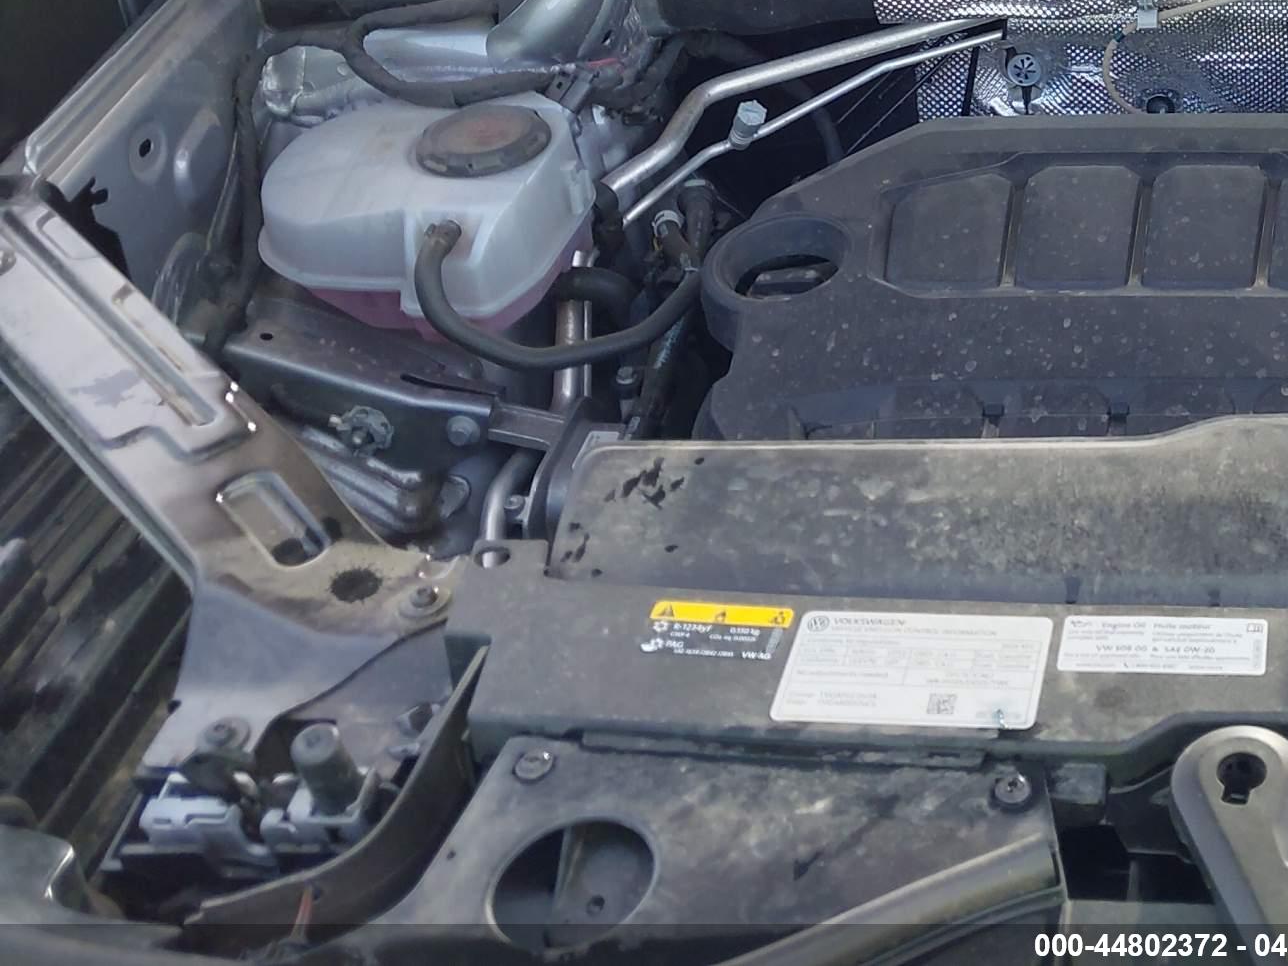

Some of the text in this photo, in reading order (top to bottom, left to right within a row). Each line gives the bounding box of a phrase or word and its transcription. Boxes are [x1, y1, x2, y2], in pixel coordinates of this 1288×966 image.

[833, 617, 906, 626] VOLKSWAGEN
[665, 640, 684, 648] PAG
[1096, 644, 1113, 652] VW
[742, 651, 756, 659] VW
[757, 652, 771, 660] AG
